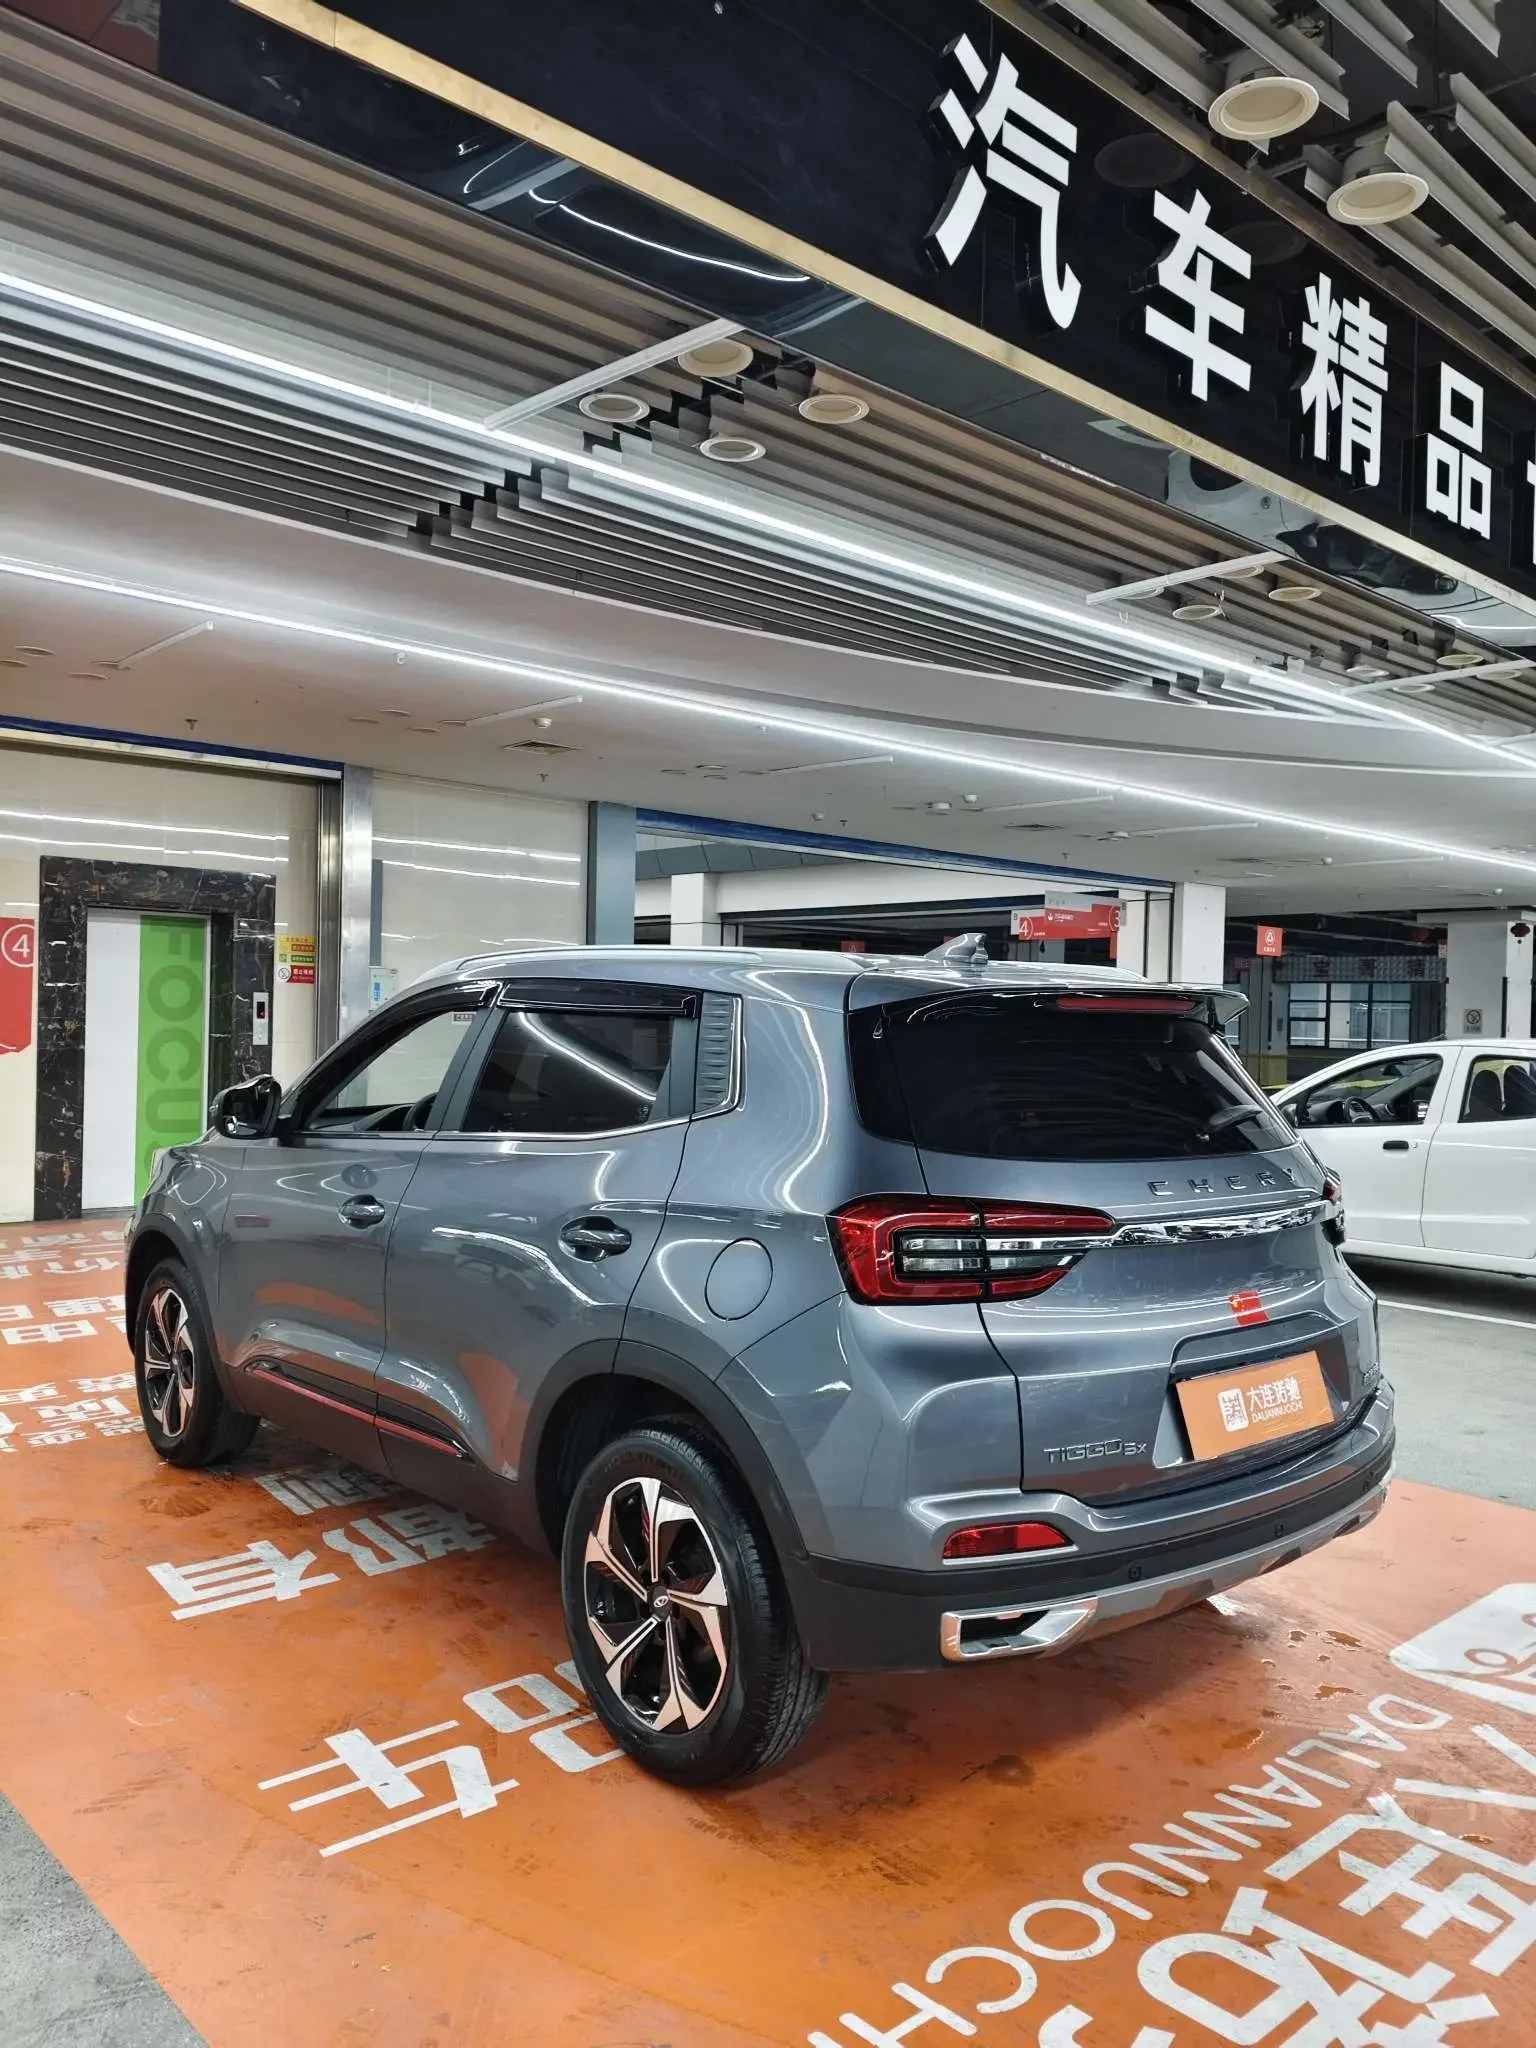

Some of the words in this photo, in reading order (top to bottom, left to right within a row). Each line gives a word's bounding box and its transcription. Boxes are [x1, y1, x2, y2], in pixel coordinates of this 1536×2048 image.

[935, 33, 1536, 565] 汽车精品
[1147, 1167, 1296, 1197] CHERY
[146, 1502, 498, 1621] 都有
